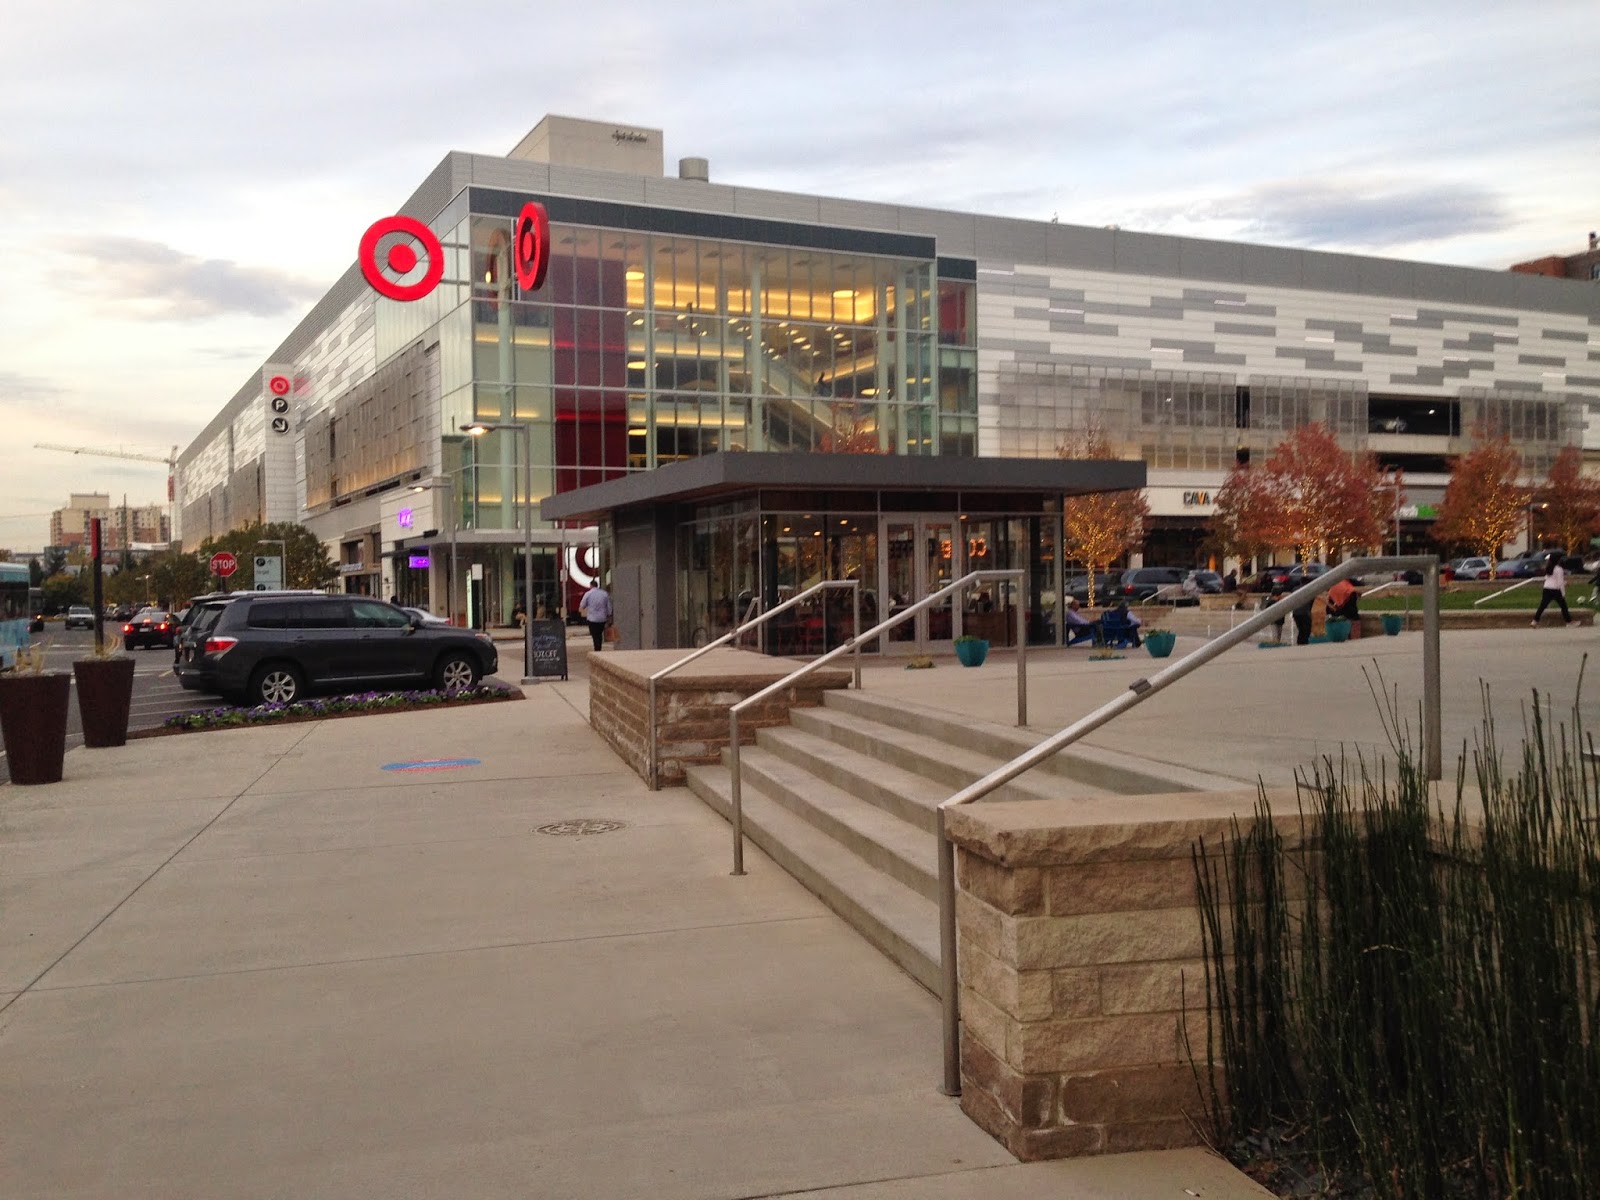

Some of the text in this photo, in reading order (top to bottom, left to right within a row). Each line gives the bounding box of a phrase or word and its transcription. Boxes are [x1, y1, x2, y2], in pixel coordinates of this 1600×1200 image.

[275, 399, 285, 411] P
[1183, 491, 1210, 505] CAVA
[212, 559, 235, 570] STOP
